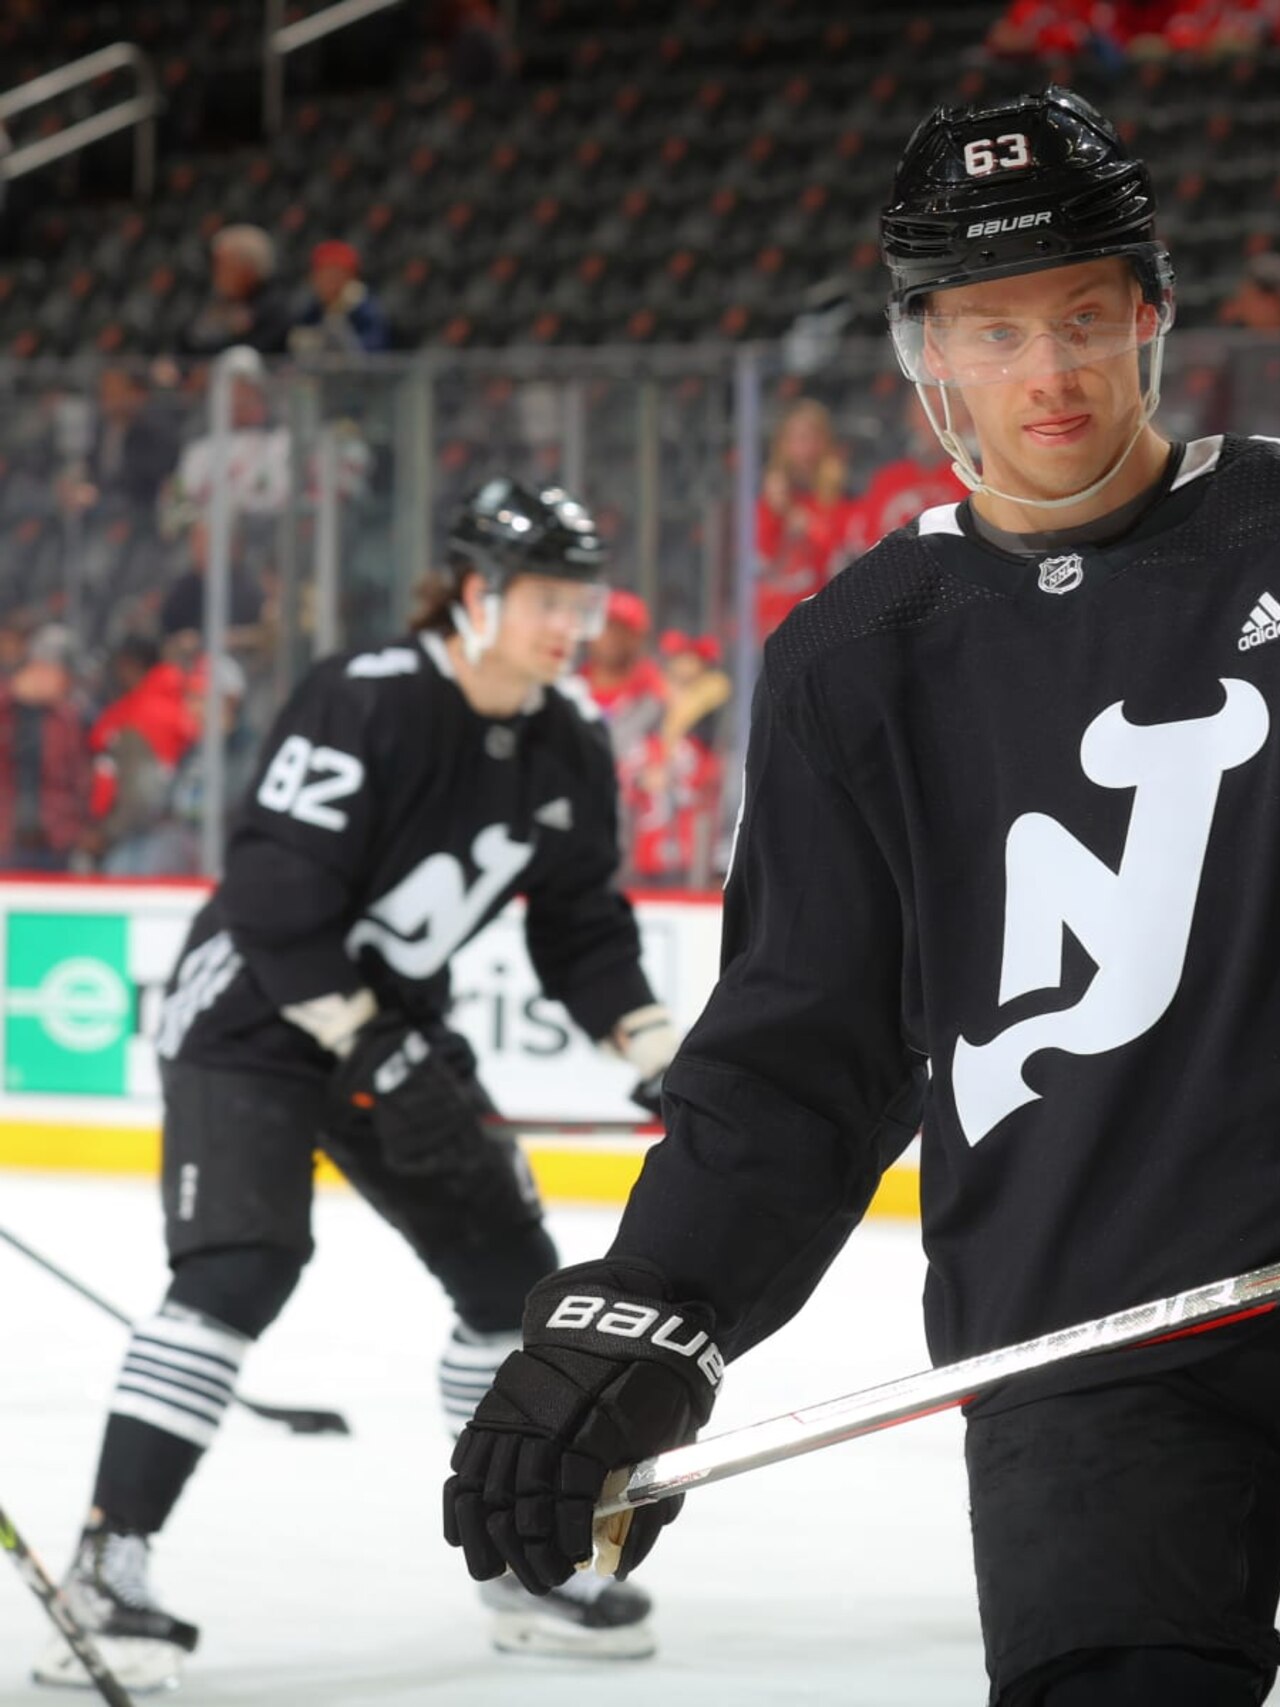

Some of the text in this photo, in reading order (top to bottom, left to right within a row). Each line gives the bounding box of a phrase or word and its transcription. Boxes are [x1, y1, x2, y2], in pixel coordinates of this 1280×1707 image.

[964, 133, 1031, 177] 63
[966, 210, 1053, 239] BAUER
[257, 733, 364, 832] 82
[546, 1295, 725, 1397] BAUE
